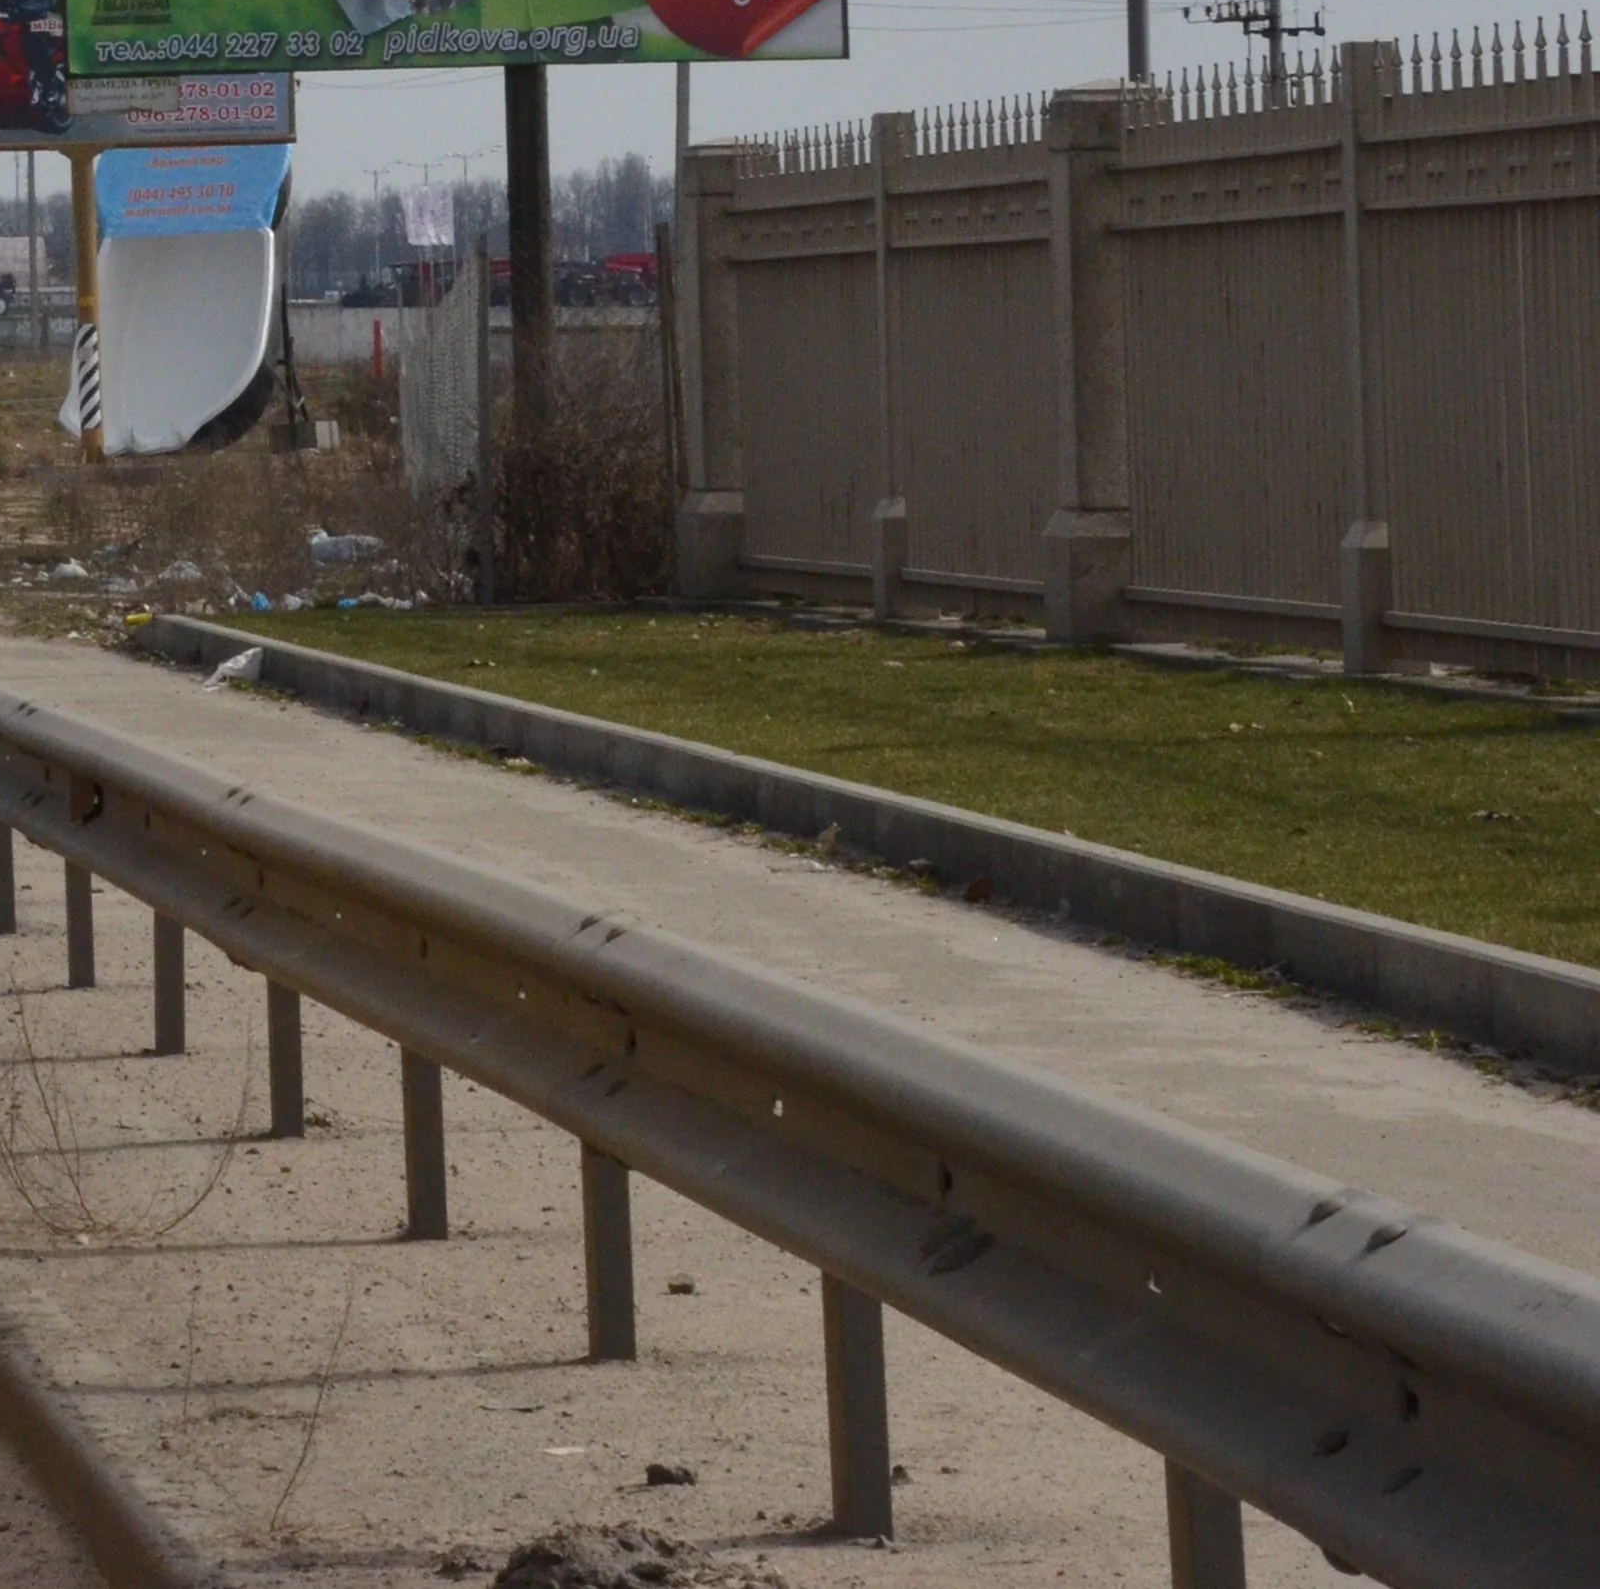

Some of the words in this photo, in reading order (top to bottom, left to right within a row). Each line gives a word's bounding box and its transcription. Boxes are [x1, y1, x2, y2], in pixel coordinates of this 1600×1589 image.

[225, 32, 278, 58] 227
[286, 32, 321, 57] 33
[330, 31, 364, 57] 02
[383, 22, 640, 61] pidkova.org.ua
